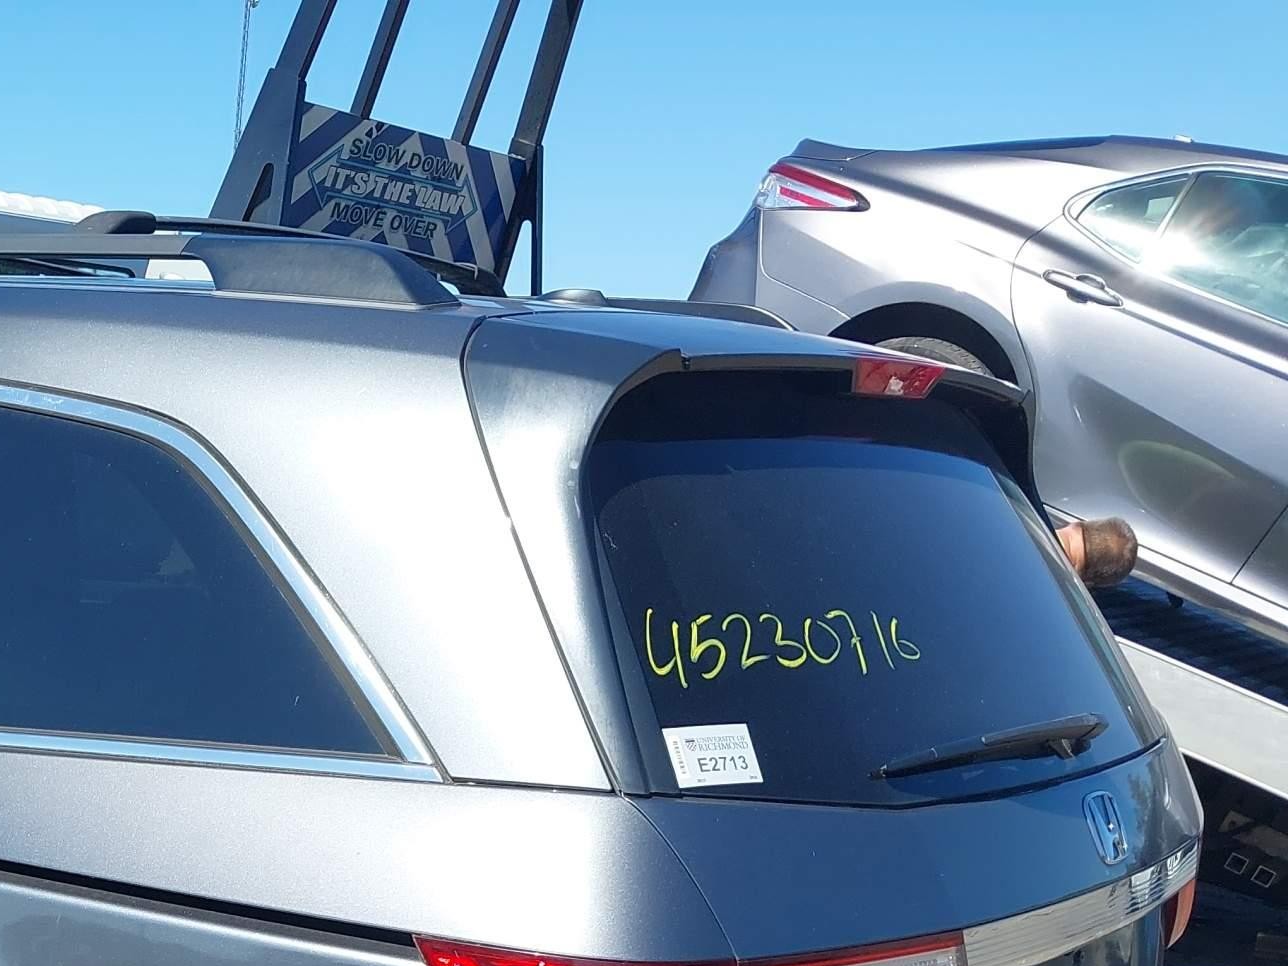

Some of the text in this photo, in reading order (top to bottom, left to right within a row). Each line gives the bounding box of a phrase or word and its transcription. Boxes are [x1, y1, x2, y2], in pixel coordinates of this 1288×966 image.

[349, 138, 464, 181] SLOW DOWN
[324, 166, 465, 215] IT'S THE LAW
[331, 202, 438, 239] MOVE OVER
[646, 608, 921, 689] 45230716
[697, 755, 749, 772] E2713
[698, 741, 749, 752] RICHMOND
